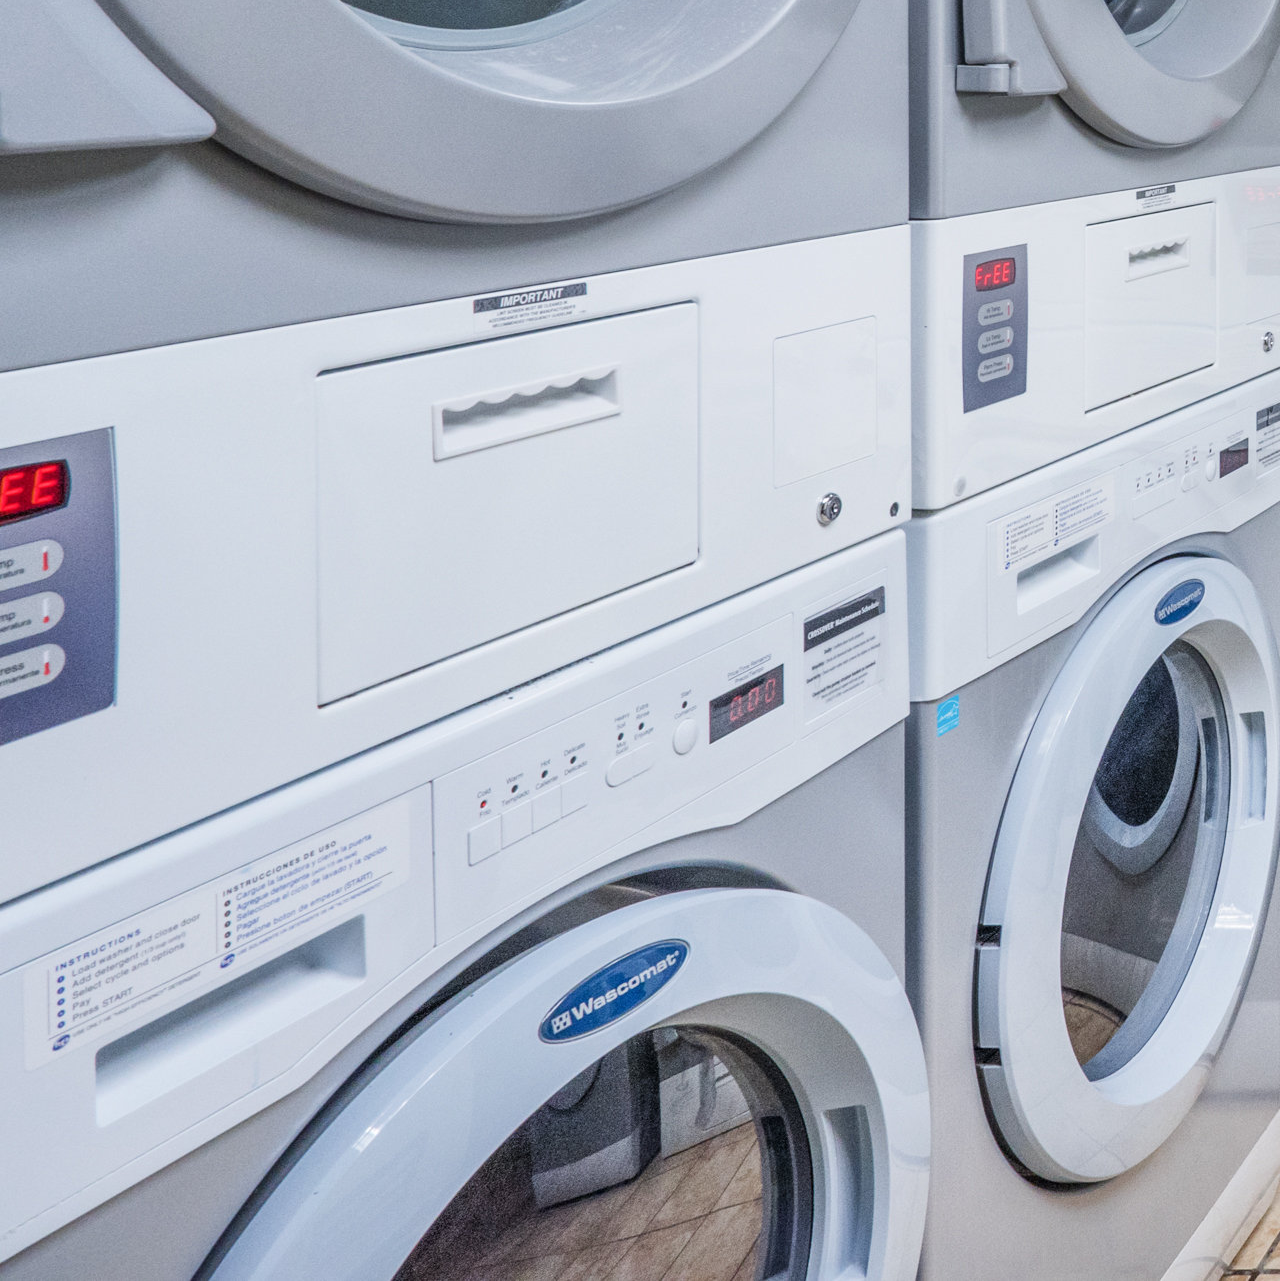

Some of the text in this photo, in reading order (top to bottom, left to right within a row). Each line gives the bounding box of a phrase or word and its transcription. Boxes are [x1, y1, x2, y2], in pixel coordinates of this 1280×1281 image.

[500, 288, 564, 308] IMPORTANT
[834, 611, 862, 628] Maintenance
[1165, 588, 1201, 615] Wascomat
[222, 856, 300, 898] INSTRUCCIONES
[303, 850, 315, 860] DE
[318, 840, 337, 853] USO
[236, 882, 266, 902] Cargue
[276, 862, 310, 883] lavadora
[236, 896, 281, 922] Seleccione
[322, 865, 347, 882] lavado
[236, 892, 269, 912] Agregue
[236, 916, 260, 932] Pagar
[237, 921, 272, 942] Presione
[310, 884, 342, 907] empezar
[55, 928, 141, 972] INSTRUCTIONS
[72, 913, 200, 977] Load washer and close door
[72, 975, 92, 988] Add
[94, 952, 139, 978] detergent
[72, 942, 186, 1000] Select cycle and options
[571, 950, 680, 1021] Wascomat
[72, 998, 92, 1010] Pay
[72, 987, 134, 1022] Press START
